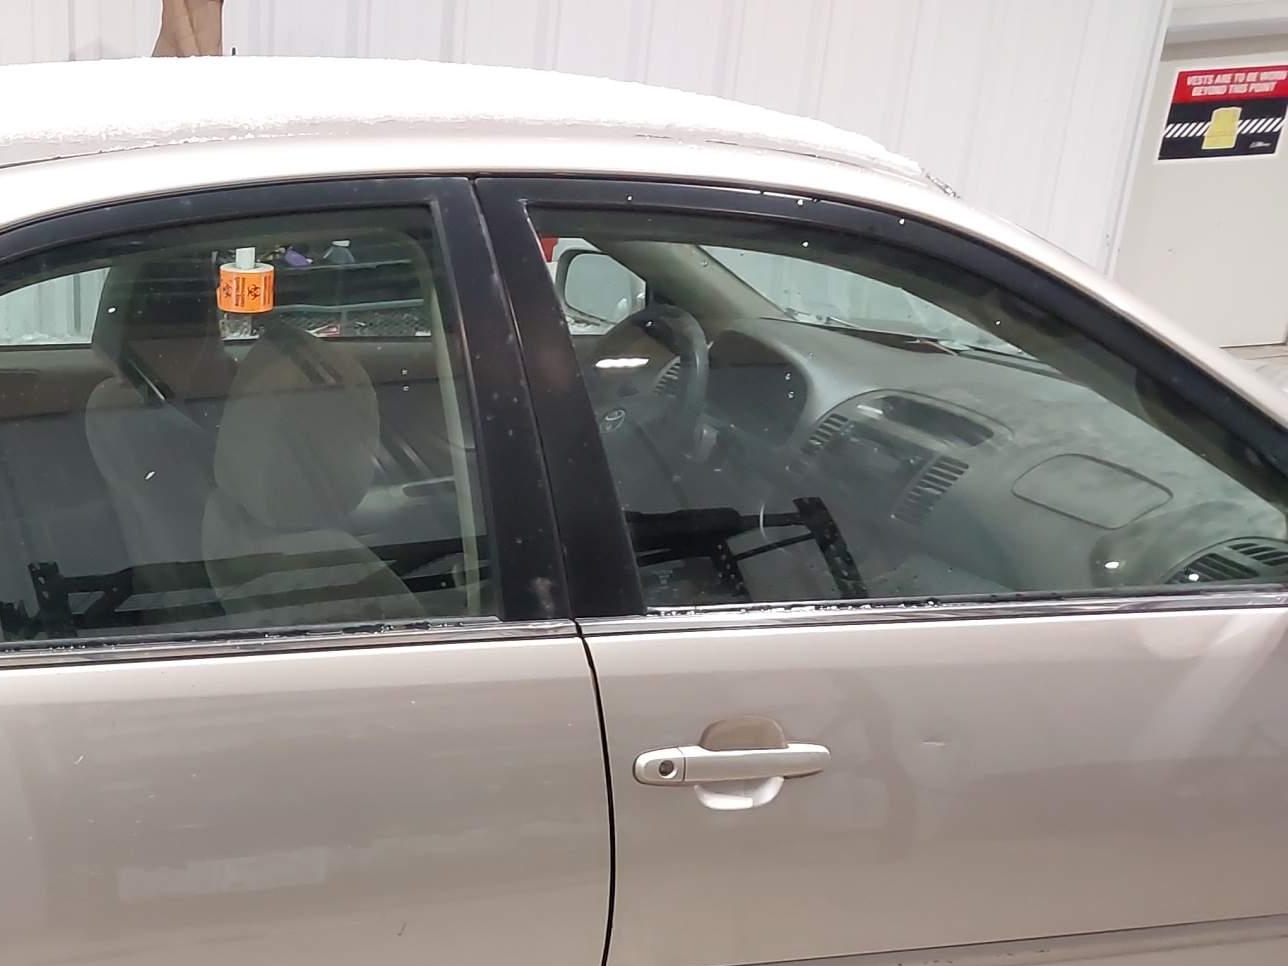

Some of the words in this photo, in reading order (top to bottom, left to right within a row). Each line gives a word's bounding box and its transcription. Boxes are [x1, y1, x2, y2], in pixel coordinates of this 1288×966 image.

[1187, 75, 1214, 85] VESTS
[1215, 74, 1233, 84] ARE
[1234, 73, 1246, 82] TO
[1246, 72, 1259, 82] BE
[1192, 85, 1227, 96] BEYOND
[1228, 83, 1249, 94] THIS
[1248, 82, 1278, 93] POINT
